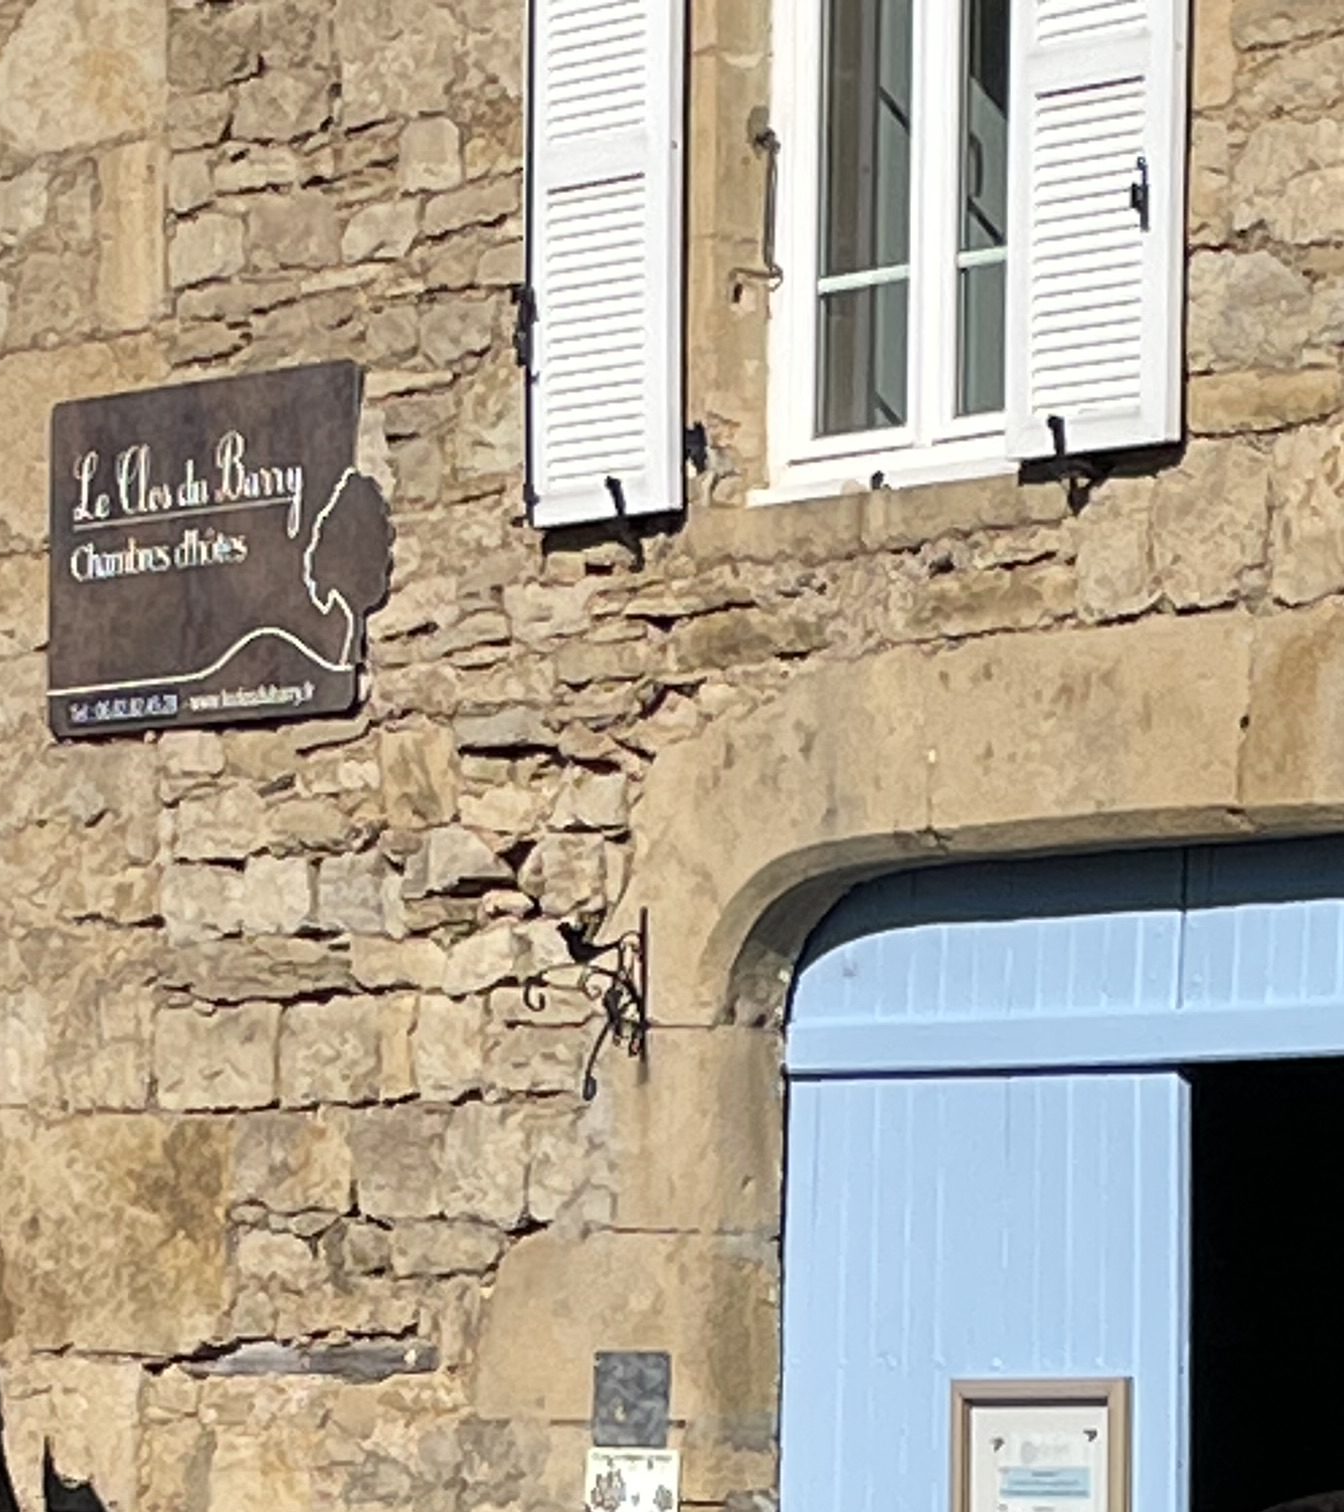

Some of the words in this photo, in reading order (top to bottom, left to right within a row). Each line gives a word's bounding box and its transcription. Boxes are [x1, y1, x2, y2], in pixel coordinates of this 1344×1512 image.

[72, 450, 111, 521] Le
[116, 442, 173, 515] Clos
[176, 458, 209, 507] du
[213, 429, 303, 539] Barry
[69, 536, 172, 583] Chambres
